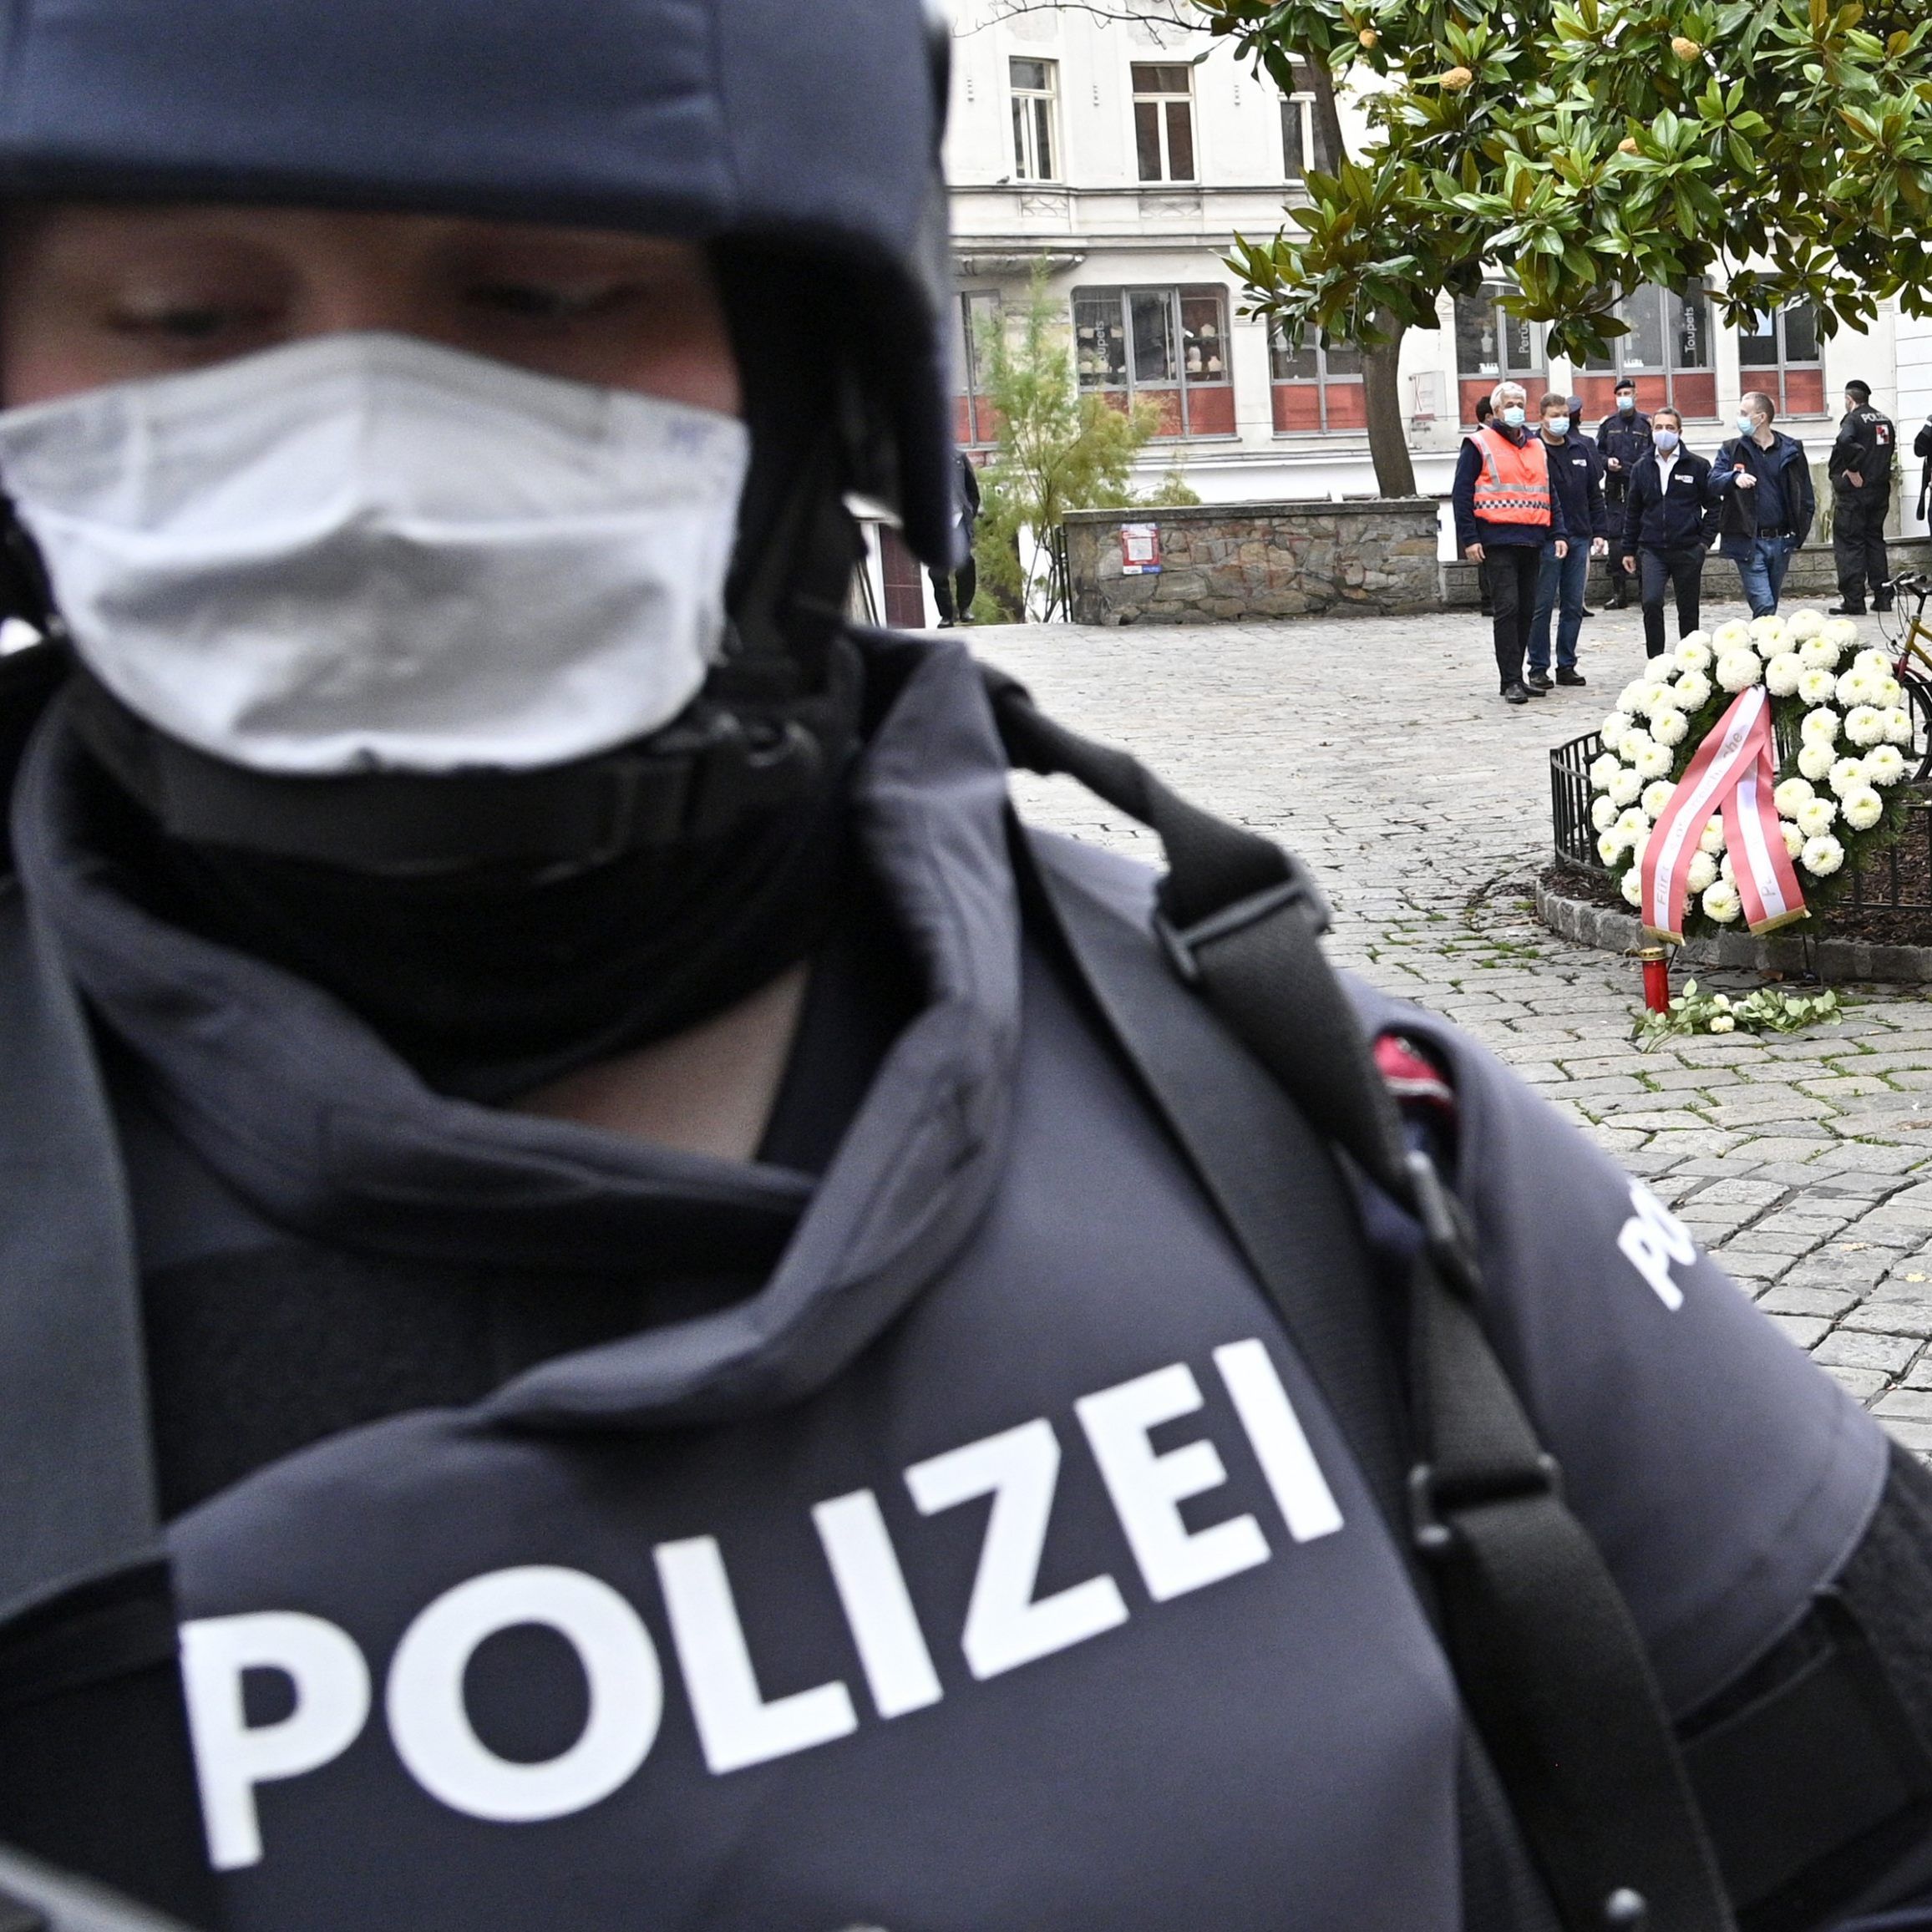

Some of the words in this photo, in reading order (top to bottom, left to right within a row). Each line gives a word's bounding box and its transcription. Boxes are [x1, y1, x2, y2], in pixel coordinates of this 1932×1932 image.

[1094, 320, 1109, 363] oupets
[1684, 307, 1697, 353] Toupets
[180, 1338, 1344, 1868] POLIZEI
